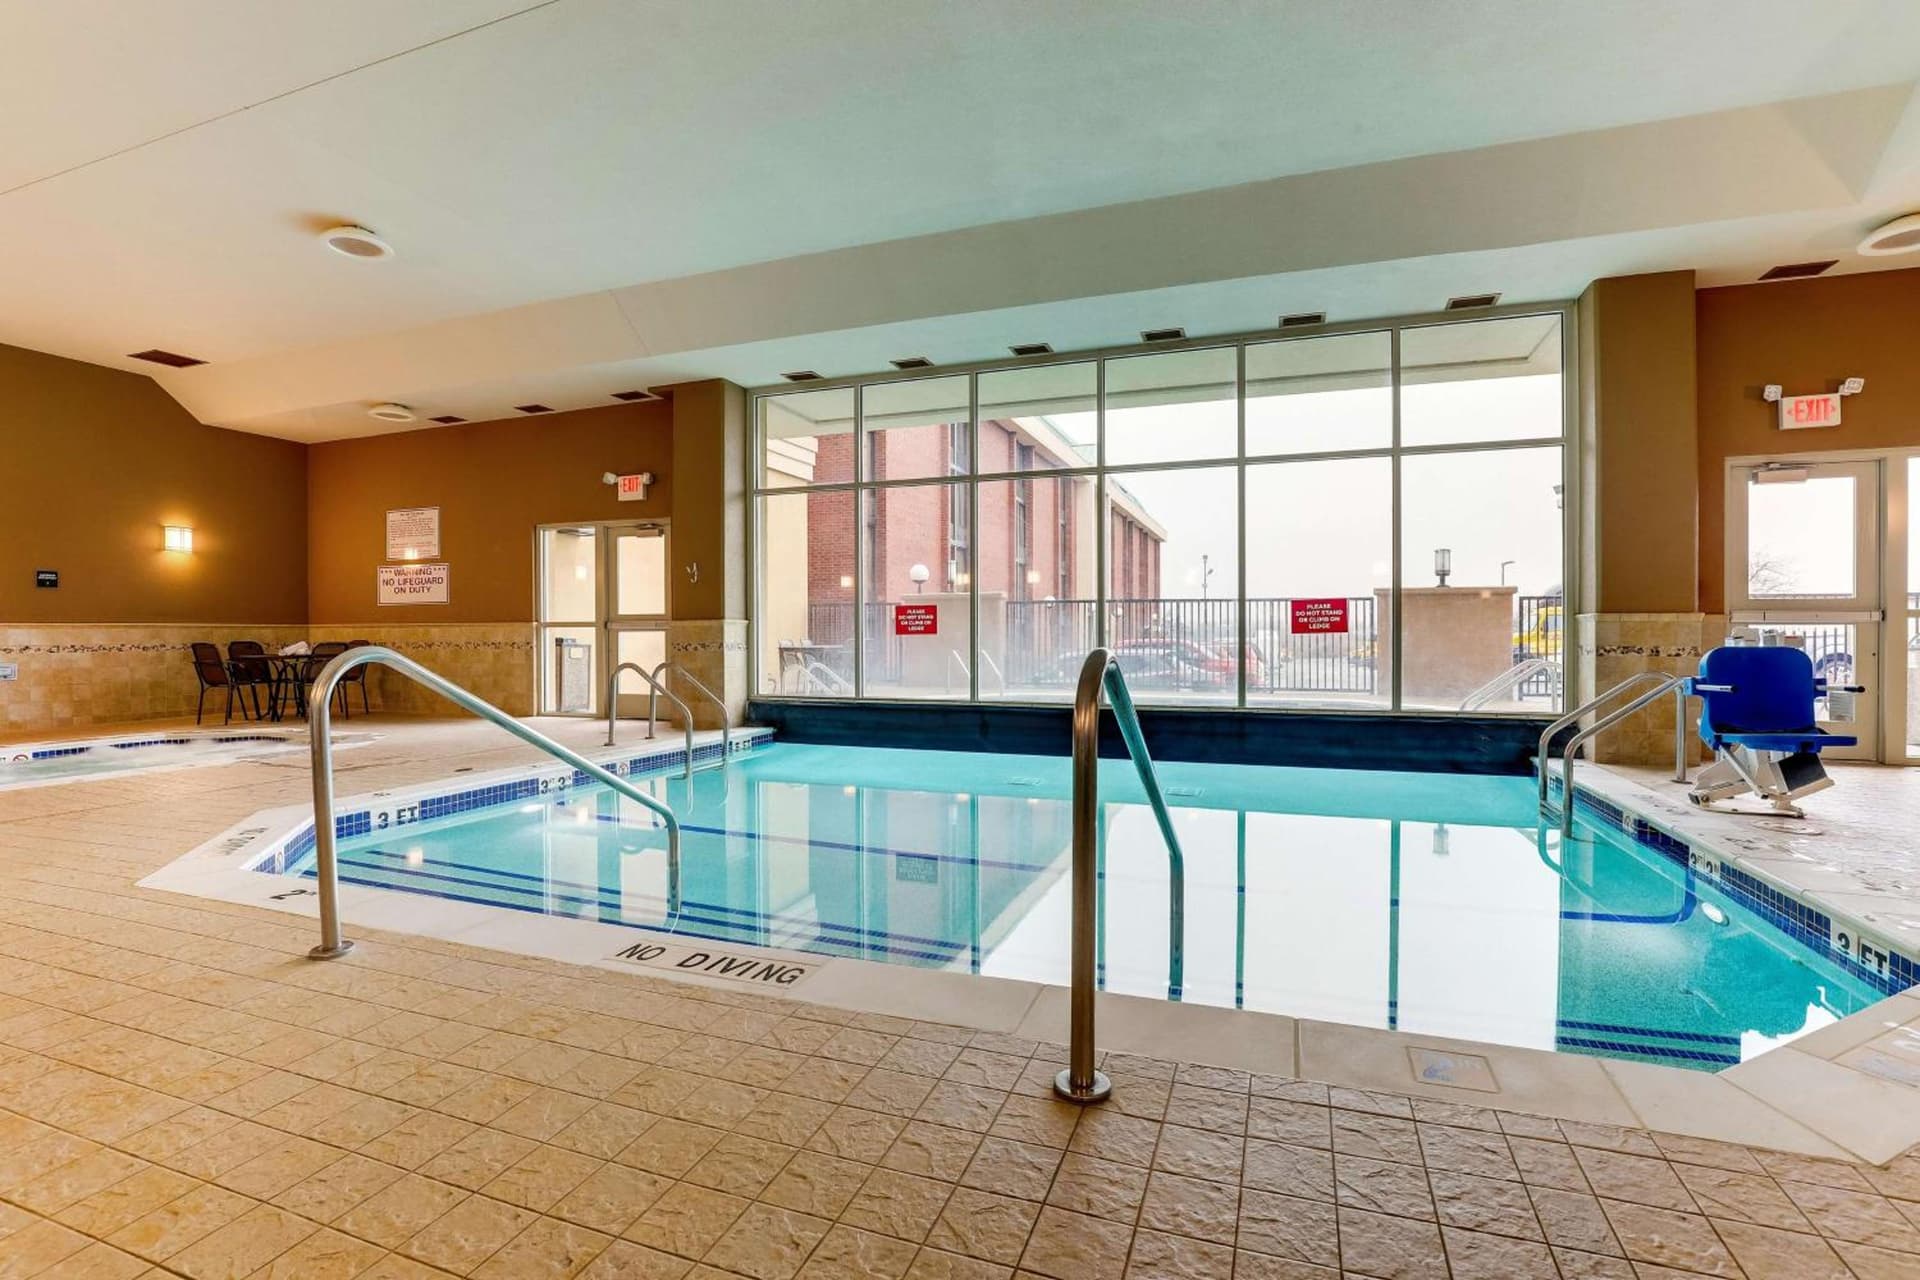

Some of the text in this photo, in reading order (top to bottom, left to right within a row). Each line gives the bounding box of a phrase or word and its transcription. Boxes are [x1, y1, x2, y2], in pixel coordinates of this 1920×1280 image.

[1794, 398, 1830, 423] EXIT
[623, 477, 640, 493] EXIT
[394, 567, 432, 577] WARNING
[382, 576, 443, 586] NO LIFEGUARD
[394, 586, 406, 594] ON
[378, 811, 389, 829] 3
[616, 943, 805, 984] NO DIVING
[1861, 943, 1888, 975] FT
